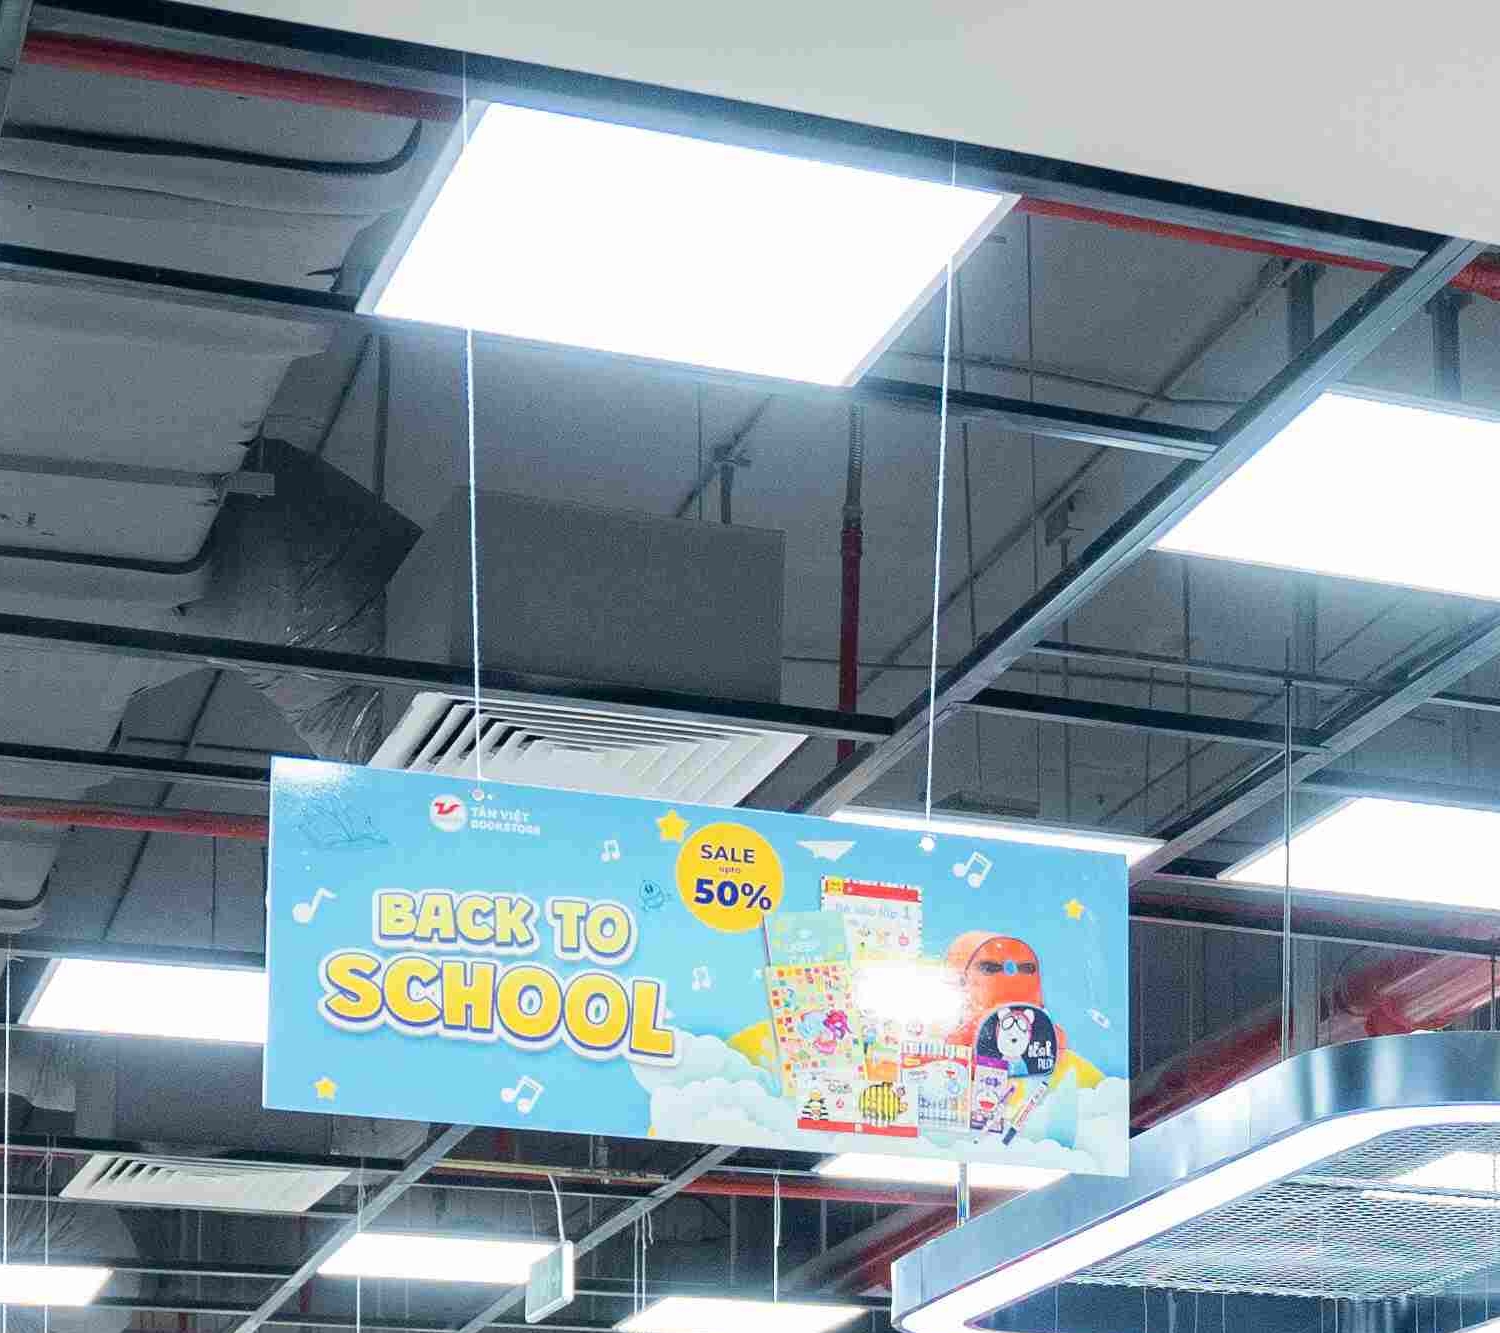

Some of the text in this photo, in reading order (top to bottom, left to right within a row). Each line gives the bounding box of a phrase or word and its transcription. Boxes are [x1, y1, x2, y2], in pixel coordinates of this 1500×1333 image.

[700, 843, 756, 864] SALE
[693, 877, 773, 910] 50%
[377, 890, 632, 956] BACK TO
[323, 951, 676, 1058] SCHOOL
